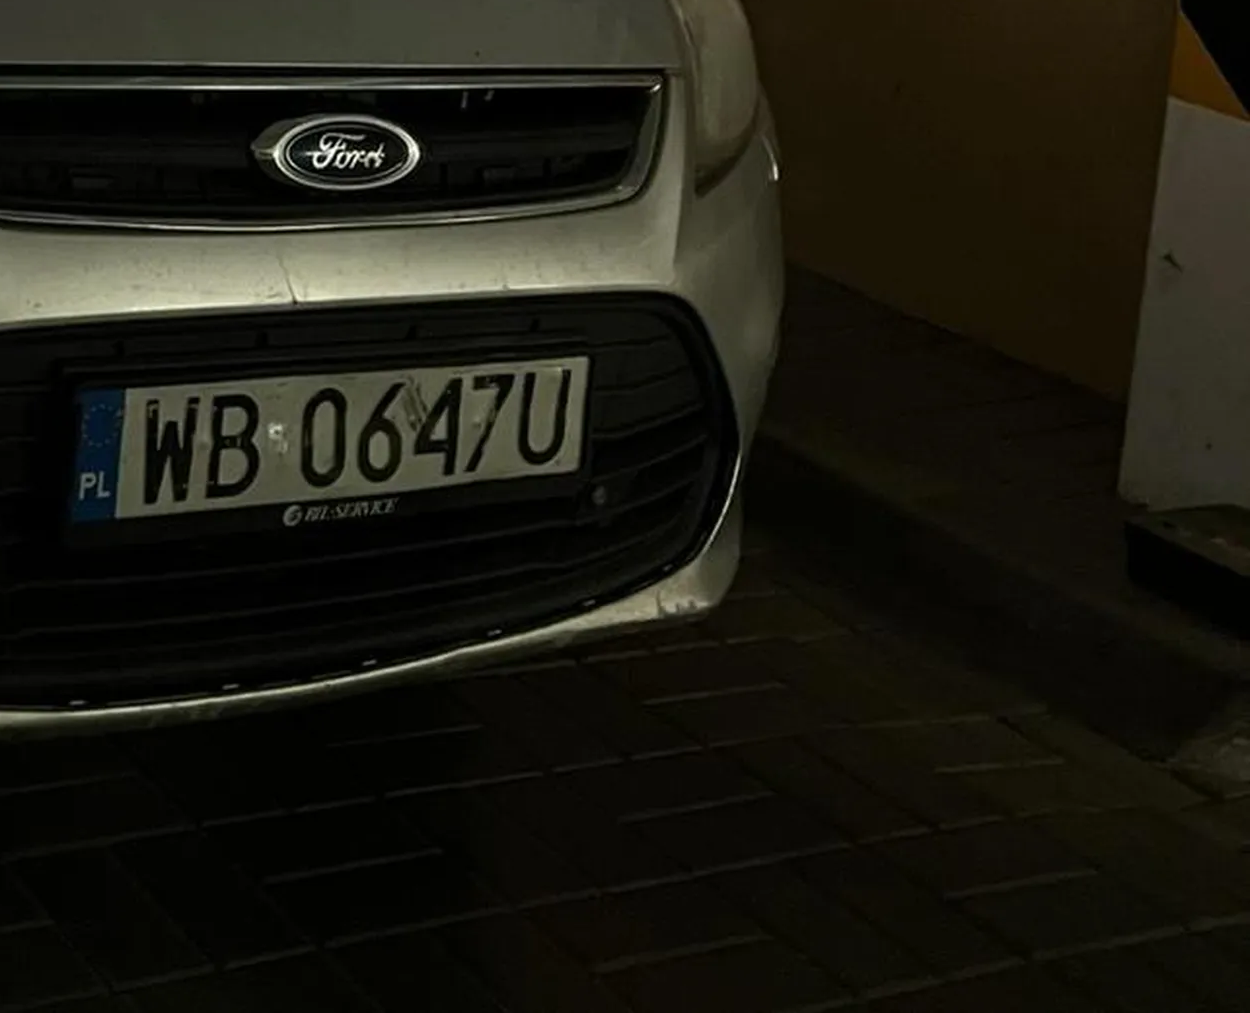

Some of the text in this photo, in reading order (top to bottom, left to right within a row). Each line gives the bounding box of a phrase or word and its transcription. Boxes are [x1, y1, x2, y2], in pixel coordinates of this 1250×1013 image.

[305, 132, 385, 169] Ford
[144, 369, 571, 504] WB 0647U
[78, 470, 111, 501] PL
